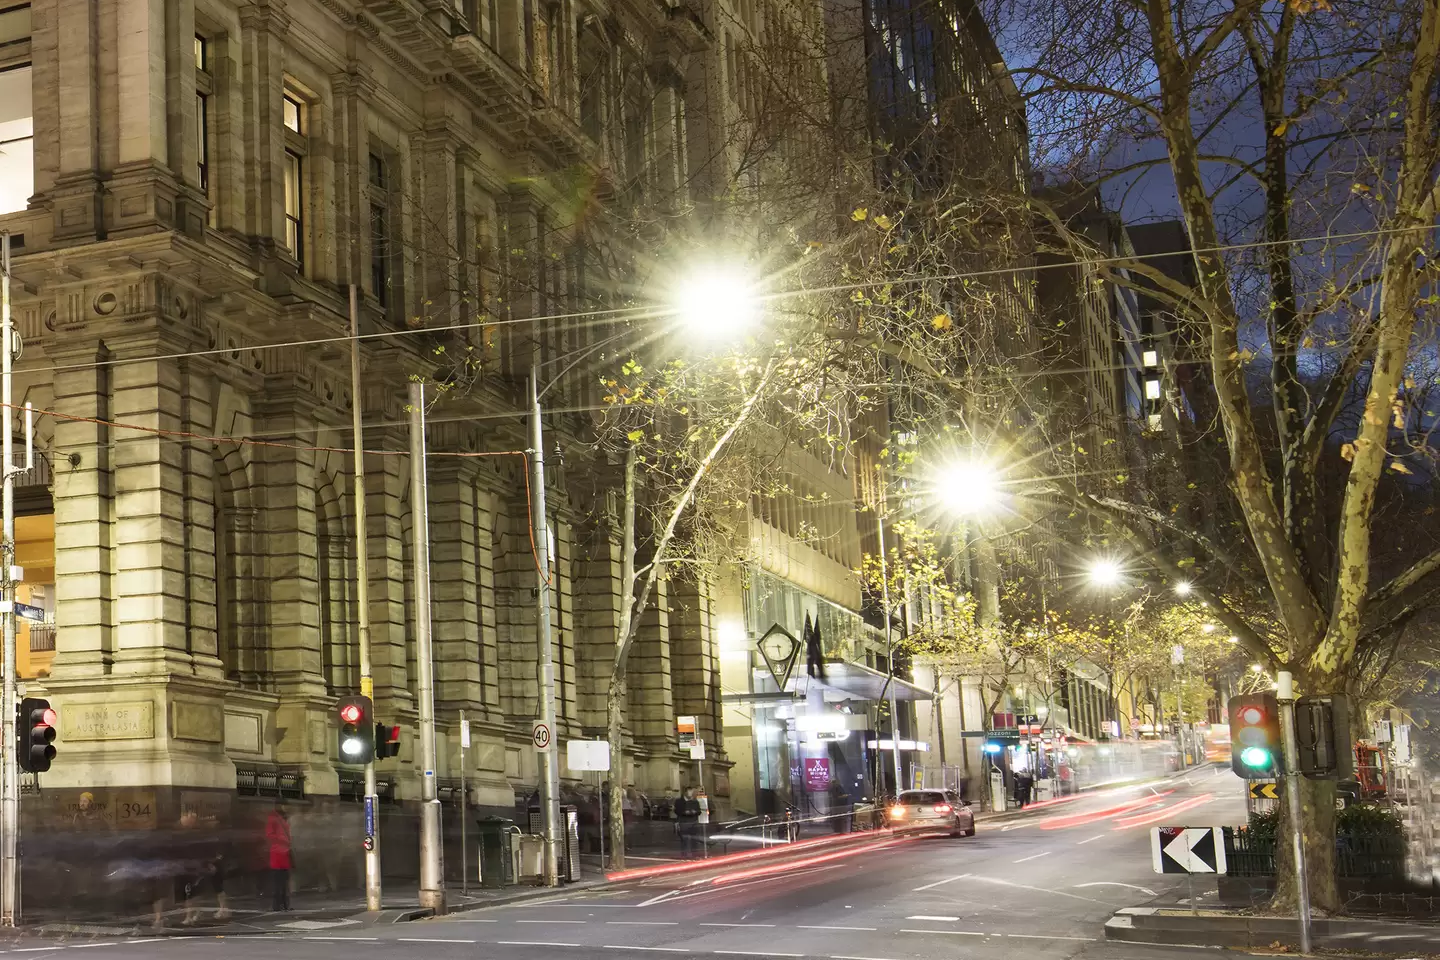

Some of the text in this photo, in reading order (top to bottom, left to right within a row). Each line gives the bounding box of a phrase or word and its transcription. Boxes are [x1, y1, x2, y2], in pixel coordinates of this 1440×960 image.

[84, 710, 129, 721] BANK OF
[76, 722, 138, 733] AUSTRALASIA
[535, 730, 548, 742] 40
[122, 802, 152, 819] 394
